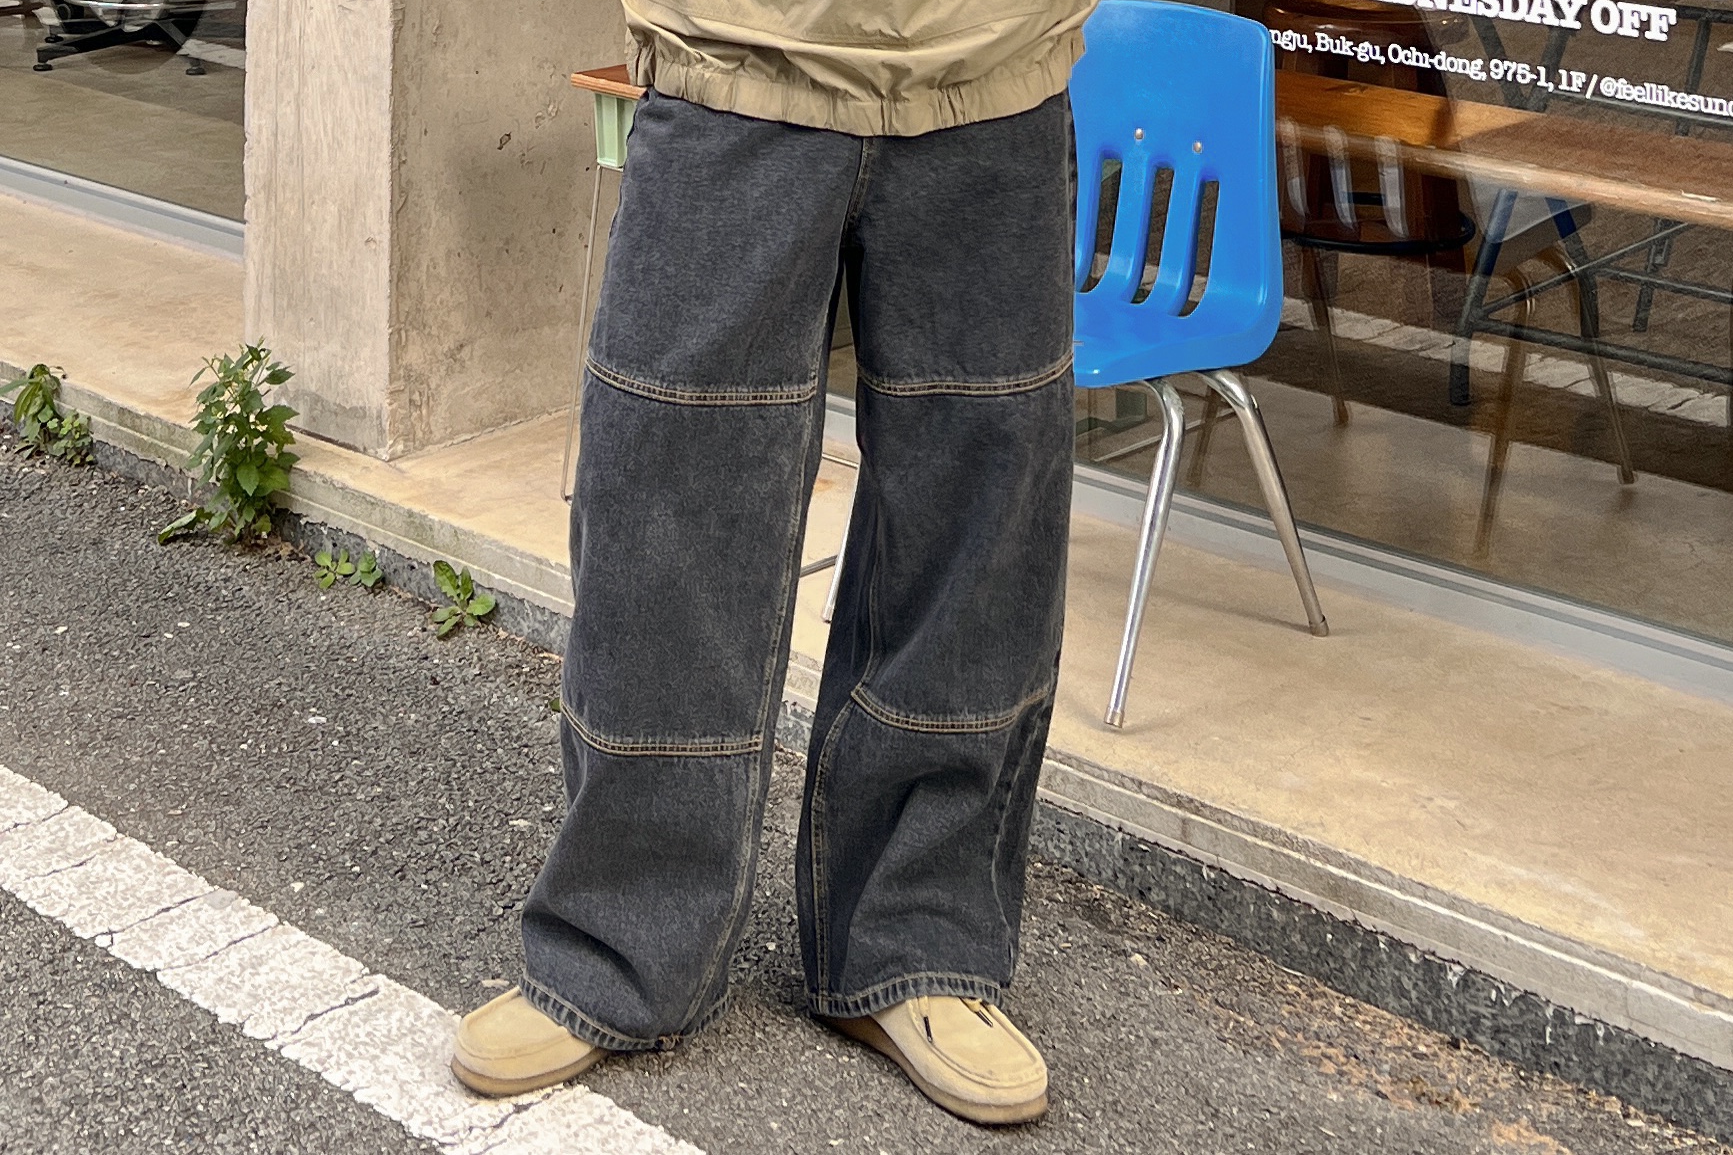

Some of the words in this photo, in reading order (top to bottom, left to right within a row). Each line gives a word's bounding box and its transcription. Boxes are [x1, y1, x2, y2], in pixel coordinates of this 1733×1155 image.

[1269, 28, 1313, 53] ngju,
[1315, 31, 1386, 64] Buk-gu,
[1489, 58, 1555, 93] 975-1,
[1558, 68, 1587, 92] 1F
[1584, 73, 1599, 99] /
[1599, 76, 1733, 118] @feellikesun
